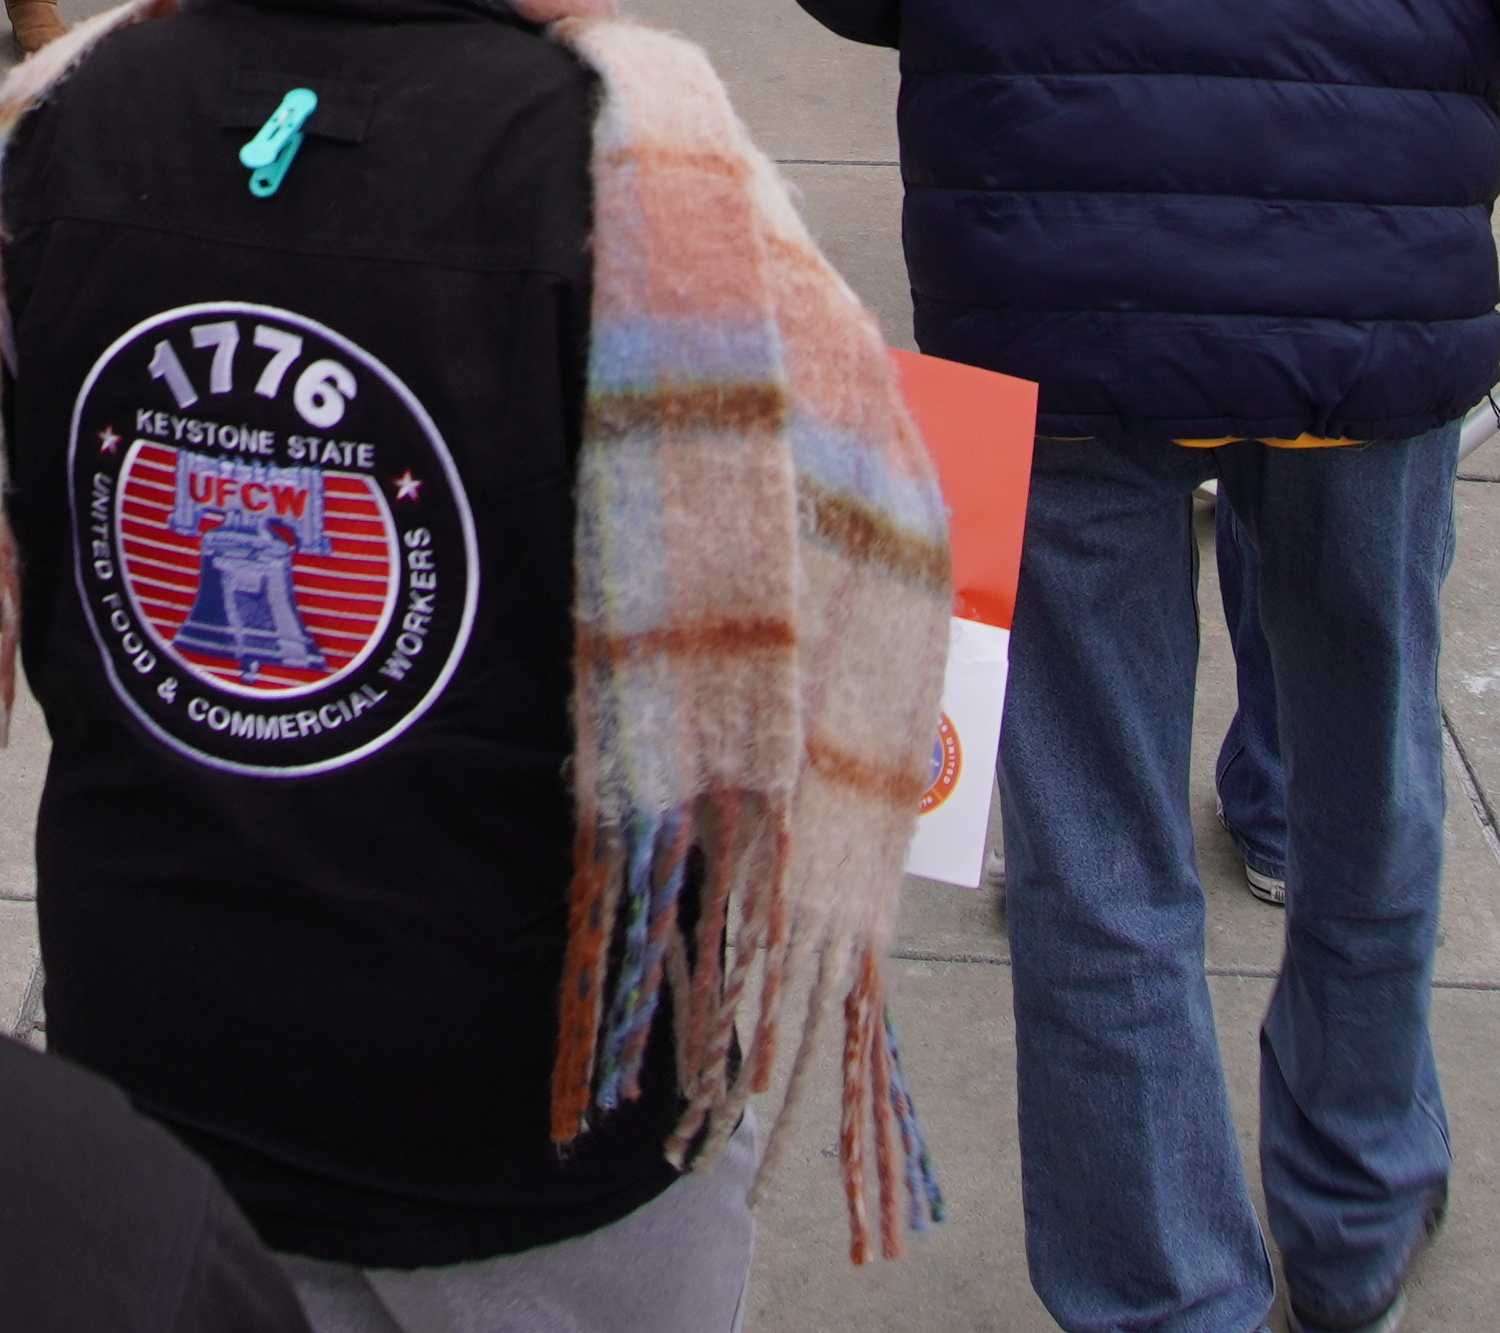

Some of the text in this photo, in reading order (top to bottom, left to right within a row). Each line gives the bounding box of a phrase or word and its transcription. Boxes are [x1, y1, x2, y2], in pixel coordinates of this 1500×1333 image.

[147, 320, 359, 430] 1776
[135, 407, 377, 467] KEYSTONE STATE
[188, 471, 309, 518] UFCW
[90, 471, 437, 741] UNITED FOOD & COMMERCIAL WORKERS
[943, 736, 956, 786] UNITED
